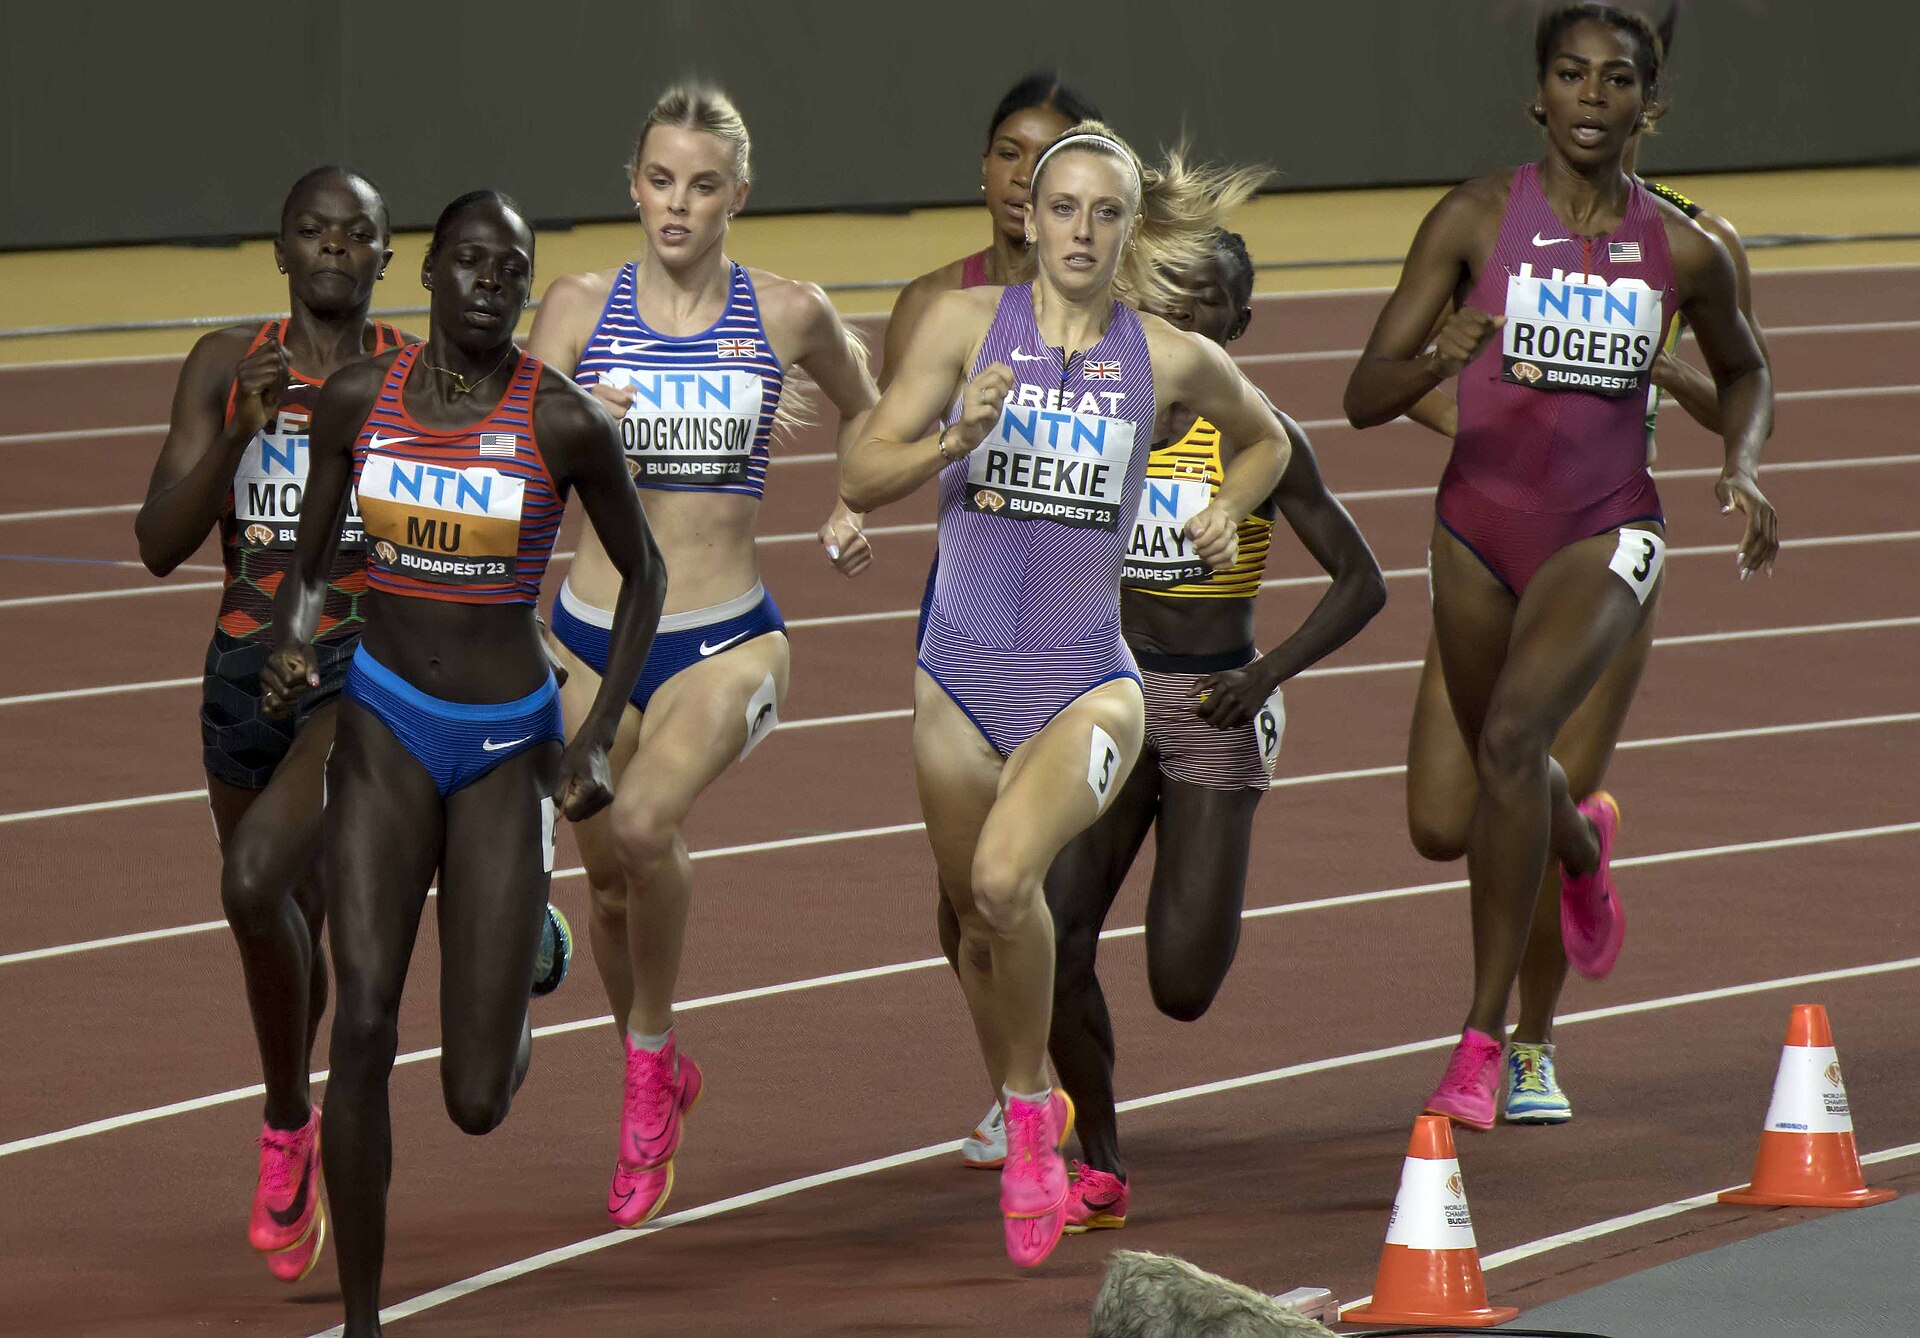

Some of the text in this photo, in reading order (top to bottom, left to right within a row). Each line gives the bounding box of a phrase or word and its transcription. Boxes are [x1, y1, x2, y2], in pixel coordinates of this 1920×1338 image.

[1538, 282, 1638, 327] NTN
[1513, 322, 1650, 368] ROGERS
[629, 374, 731, 410] NTN
[1547, 370, 1628, 389] BUDAPEST
[1004, 383, 1125, 415] REAT
[621, 417, 752, 451] ODGKINSON
[1002, 407, 1107, 456] NTN
[388, 460, 492, 513] NTN
[646, 462, 741, 475] BUDAPEST 23
[985, 449, 1110, 498] REEKIE
[1009, 498, 1112, 523] BUDAPEST 23
[406, 516, 462, 552] MU
[400, 553, 506, 576] BUDAPEST 23
[1183, 566, 1203, 578] 23
[1632, 537, 1655, 582] 3
[1260, 710, 1278, 758] 8
[1099, 746, 1115, 794] 5
